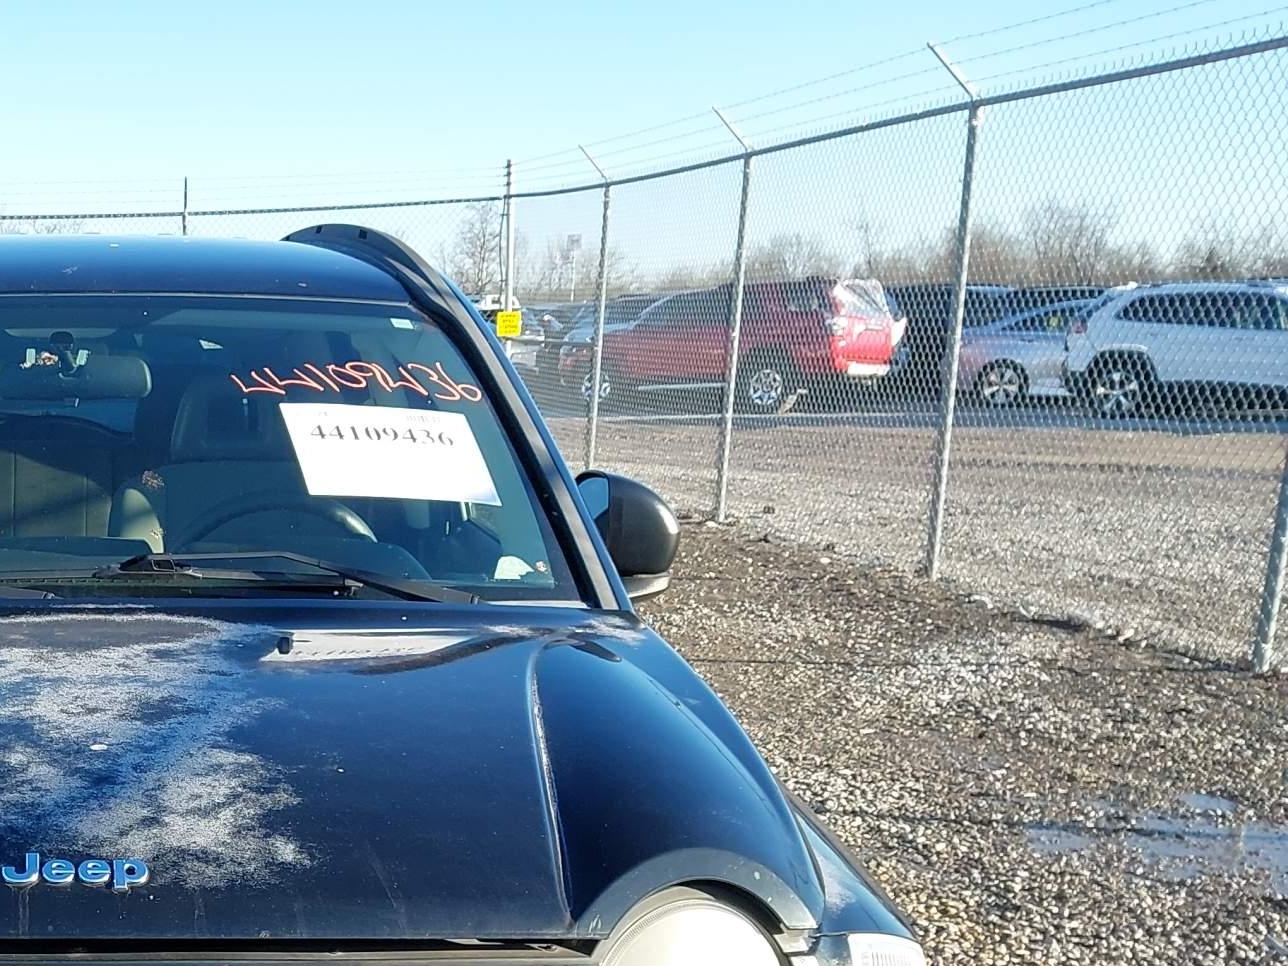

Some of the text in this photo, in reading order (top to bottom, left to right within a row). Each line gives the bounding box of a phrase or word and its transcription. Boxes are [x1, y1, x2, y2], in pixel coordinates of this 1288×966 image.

[229, 361, 483, 402] 44109436
[310, 423, 455, 447] 44109436
[1, 852, 150, 889] Jeep
